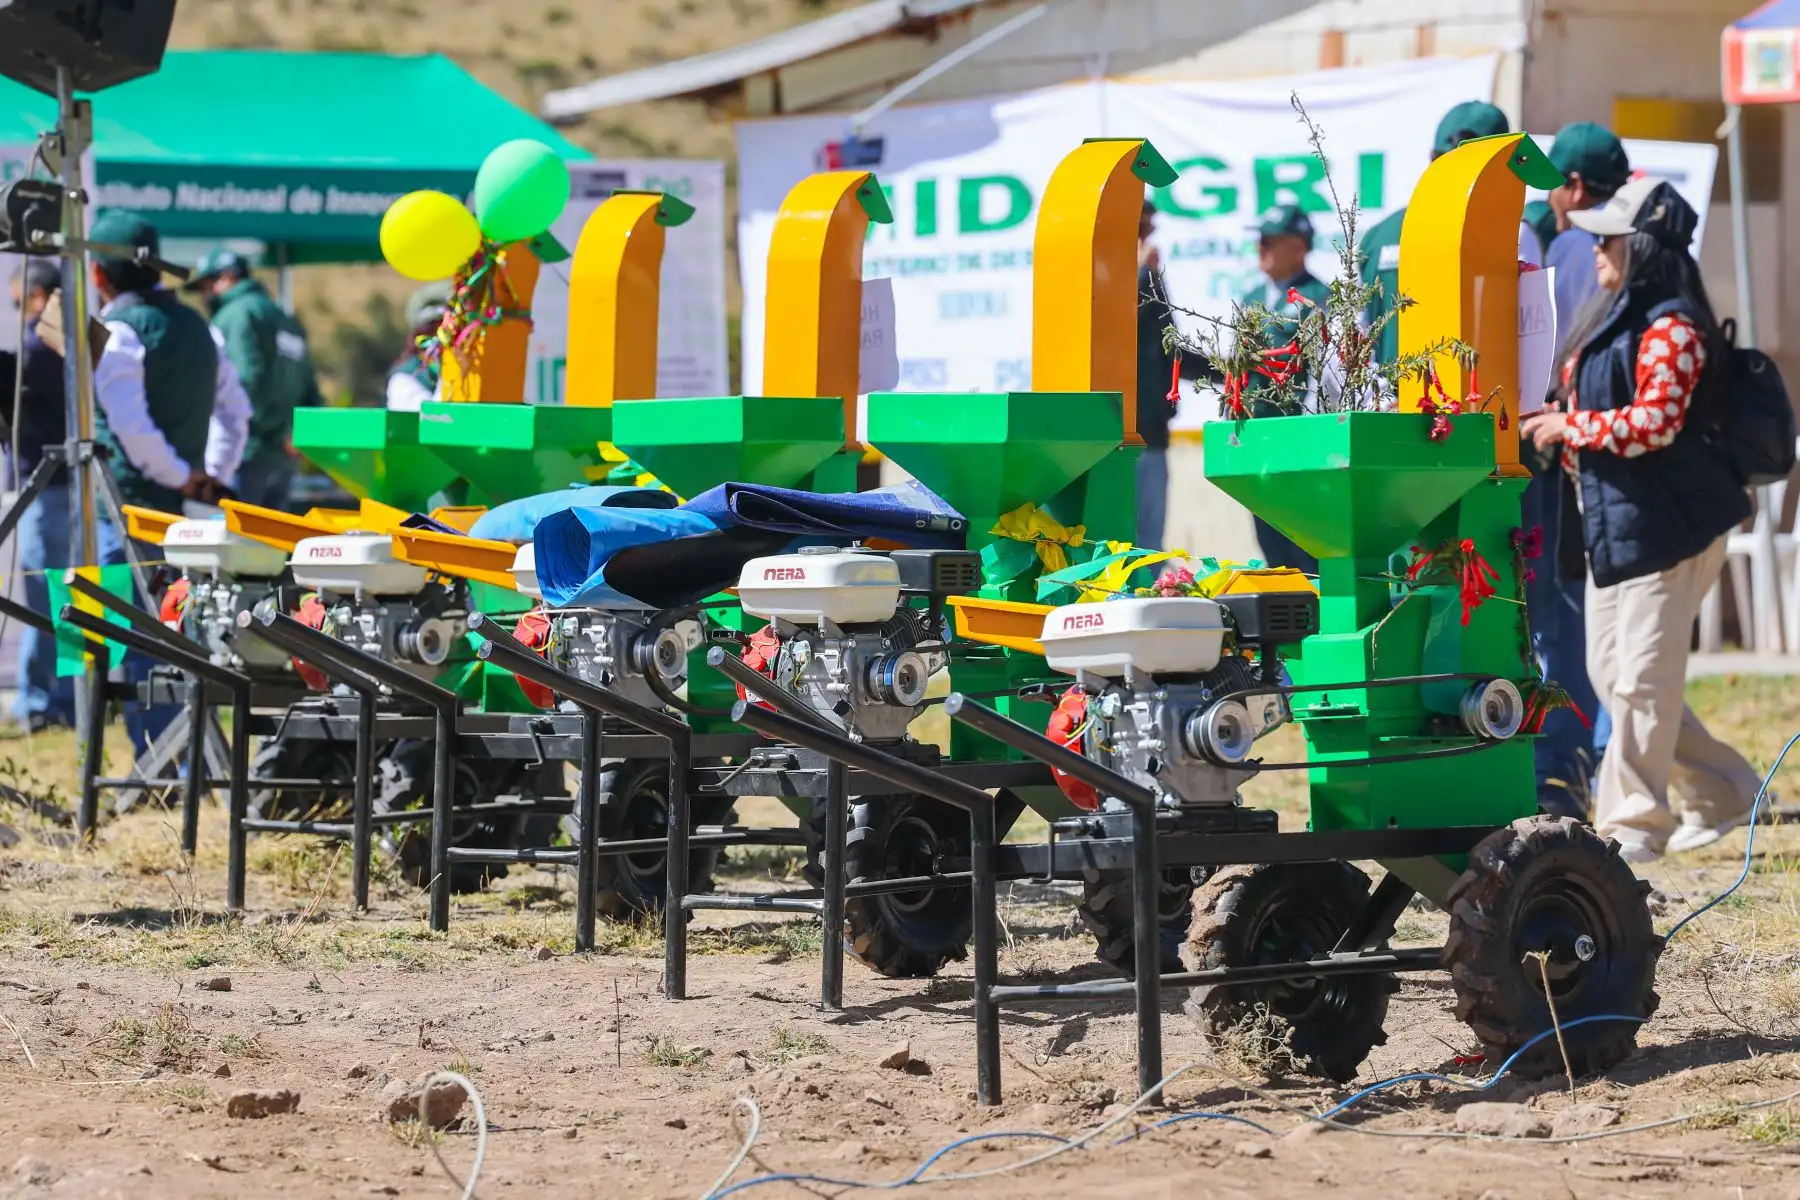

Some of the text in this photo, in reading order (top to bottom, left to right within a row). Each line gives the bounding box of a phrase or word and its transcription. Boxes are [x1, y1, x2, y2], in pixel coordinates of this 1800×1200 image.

[289, 185, 323, 215] de
[308, 546, 343, 558] NERA
[763, 567, 806, 581] NERA
[1062, 612, 1105, 630] NERA
